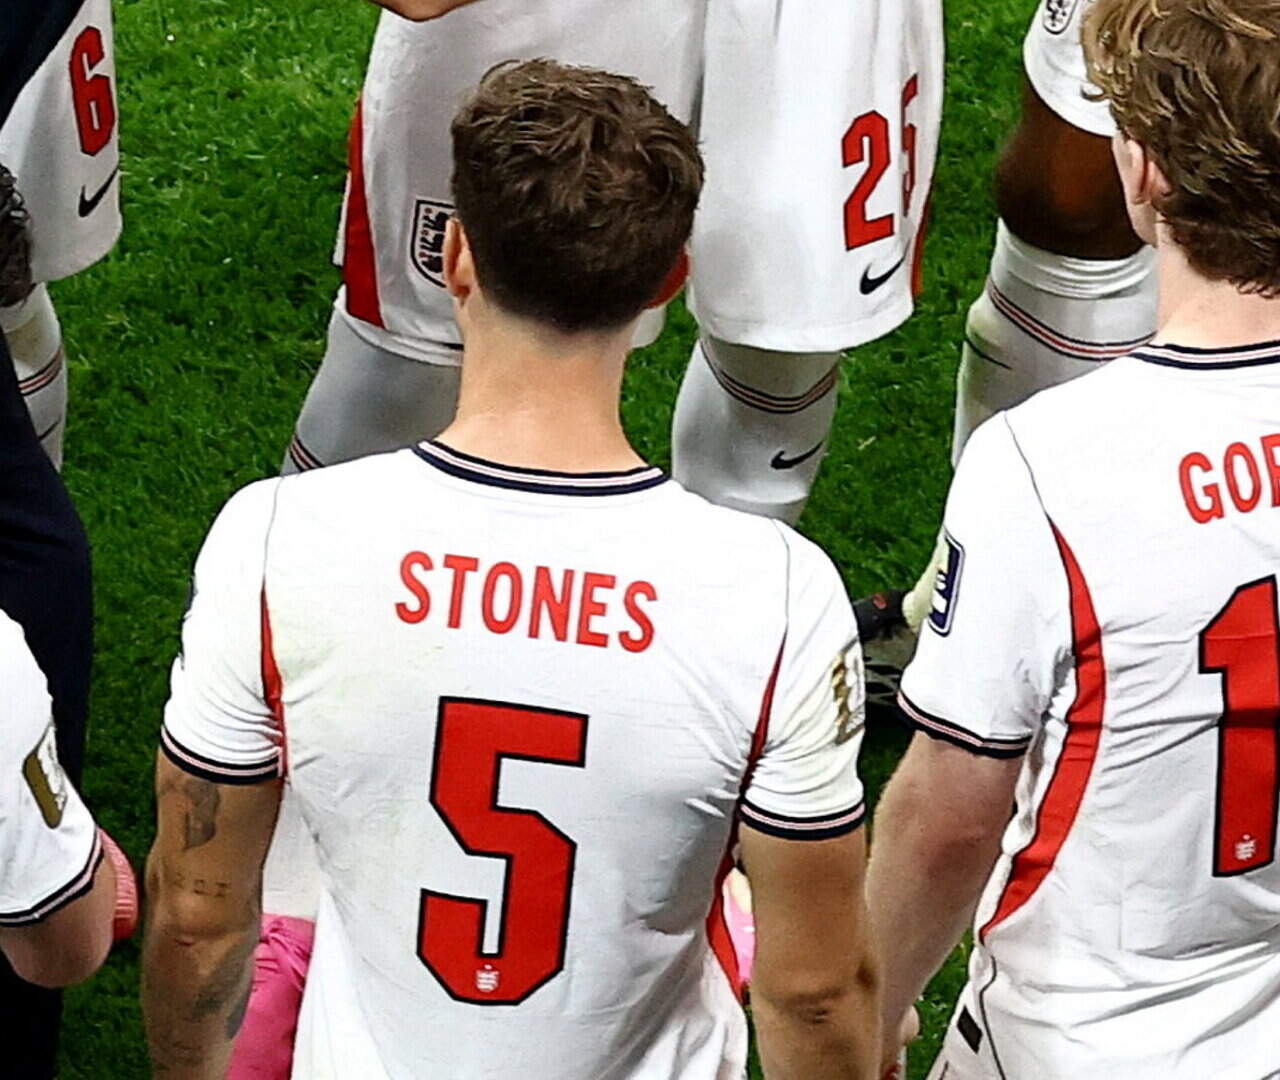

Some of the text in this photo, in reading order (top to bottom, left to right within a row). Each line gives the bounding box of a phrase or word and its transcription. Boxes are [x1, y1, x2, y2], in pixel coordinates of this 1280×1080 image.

[69, 25, 116, 156] 6
[395, 550, 659, 654] STONES
[416, 695, 590, 1007] 5
